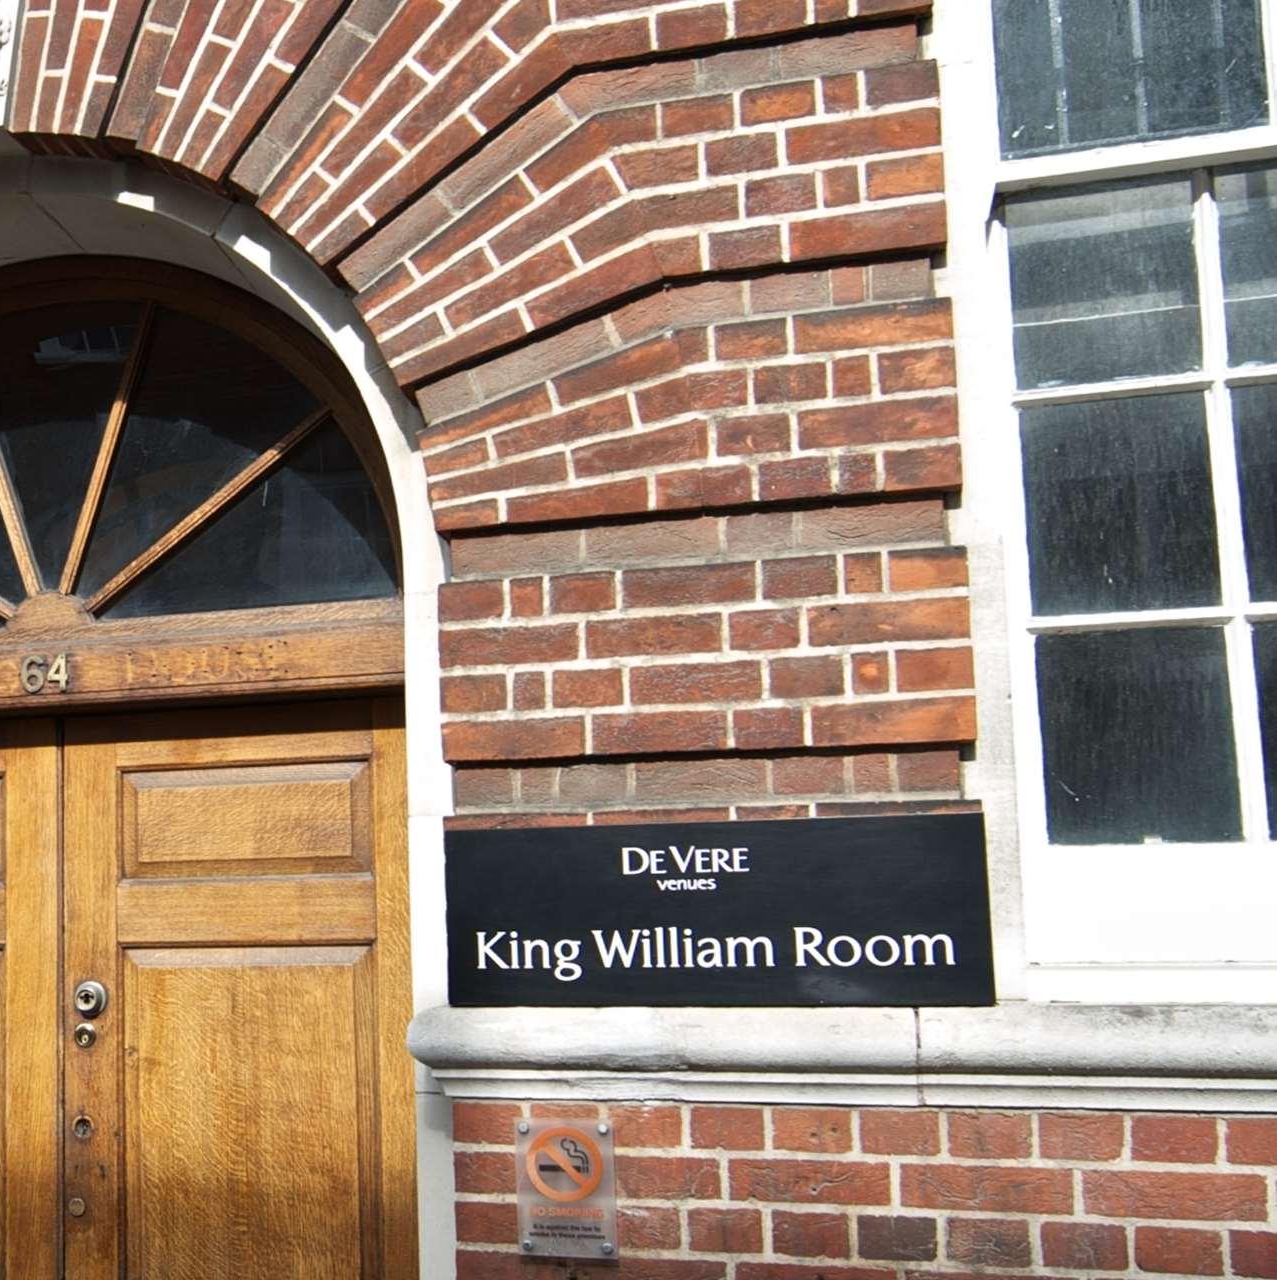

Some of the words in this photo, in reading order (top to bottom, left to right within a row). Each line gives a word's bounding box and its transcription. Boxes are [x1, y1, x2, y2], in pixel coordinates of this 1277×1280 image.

[20, 652, 69, 694] 64
[621, 846, 668, 875] DE
[668, 845, 750, 873] VERE
[656, 877, 718, 891] venues
[476, 930, 583, 982] King
[591, 926, 776, 969] William
[793, 926, 957, 968] Room
